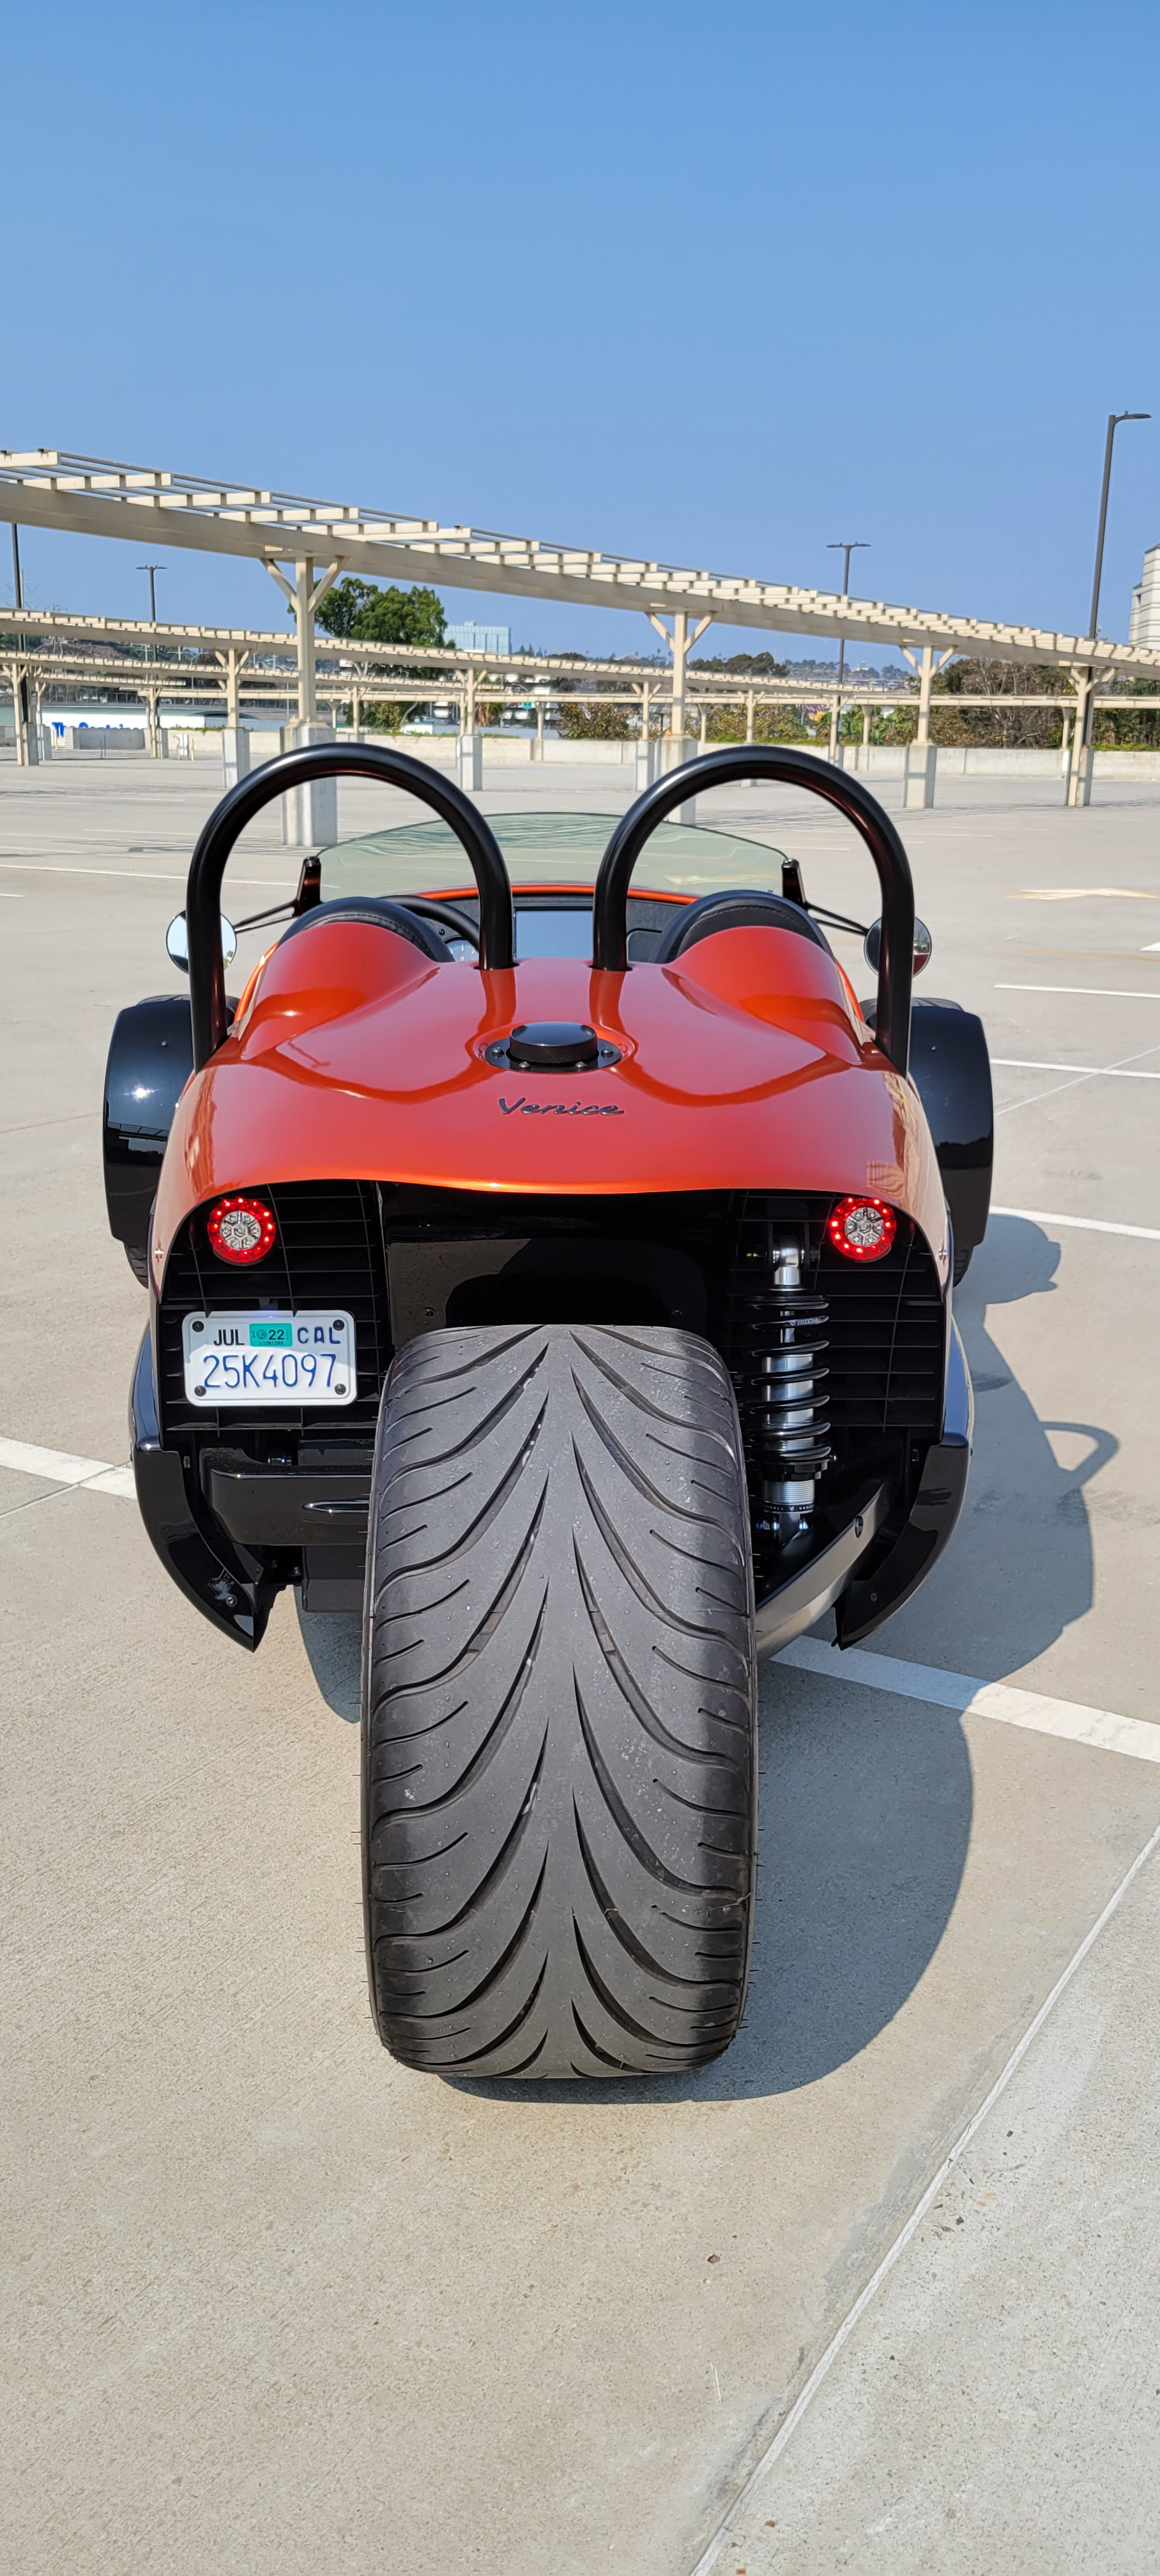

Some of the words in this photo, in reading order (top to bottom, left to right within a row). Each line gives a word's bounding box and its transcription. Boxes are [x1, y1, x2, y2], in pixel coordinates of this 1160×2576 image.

[498, 1097, 625, 1115] Venice
[213, 1329, 245, 1346] JUL
[268, 1329, 285, 1340] 22
[297, 1326, 341, 1344] CAL
[202, 1353, 337, 1388] 25K4097
